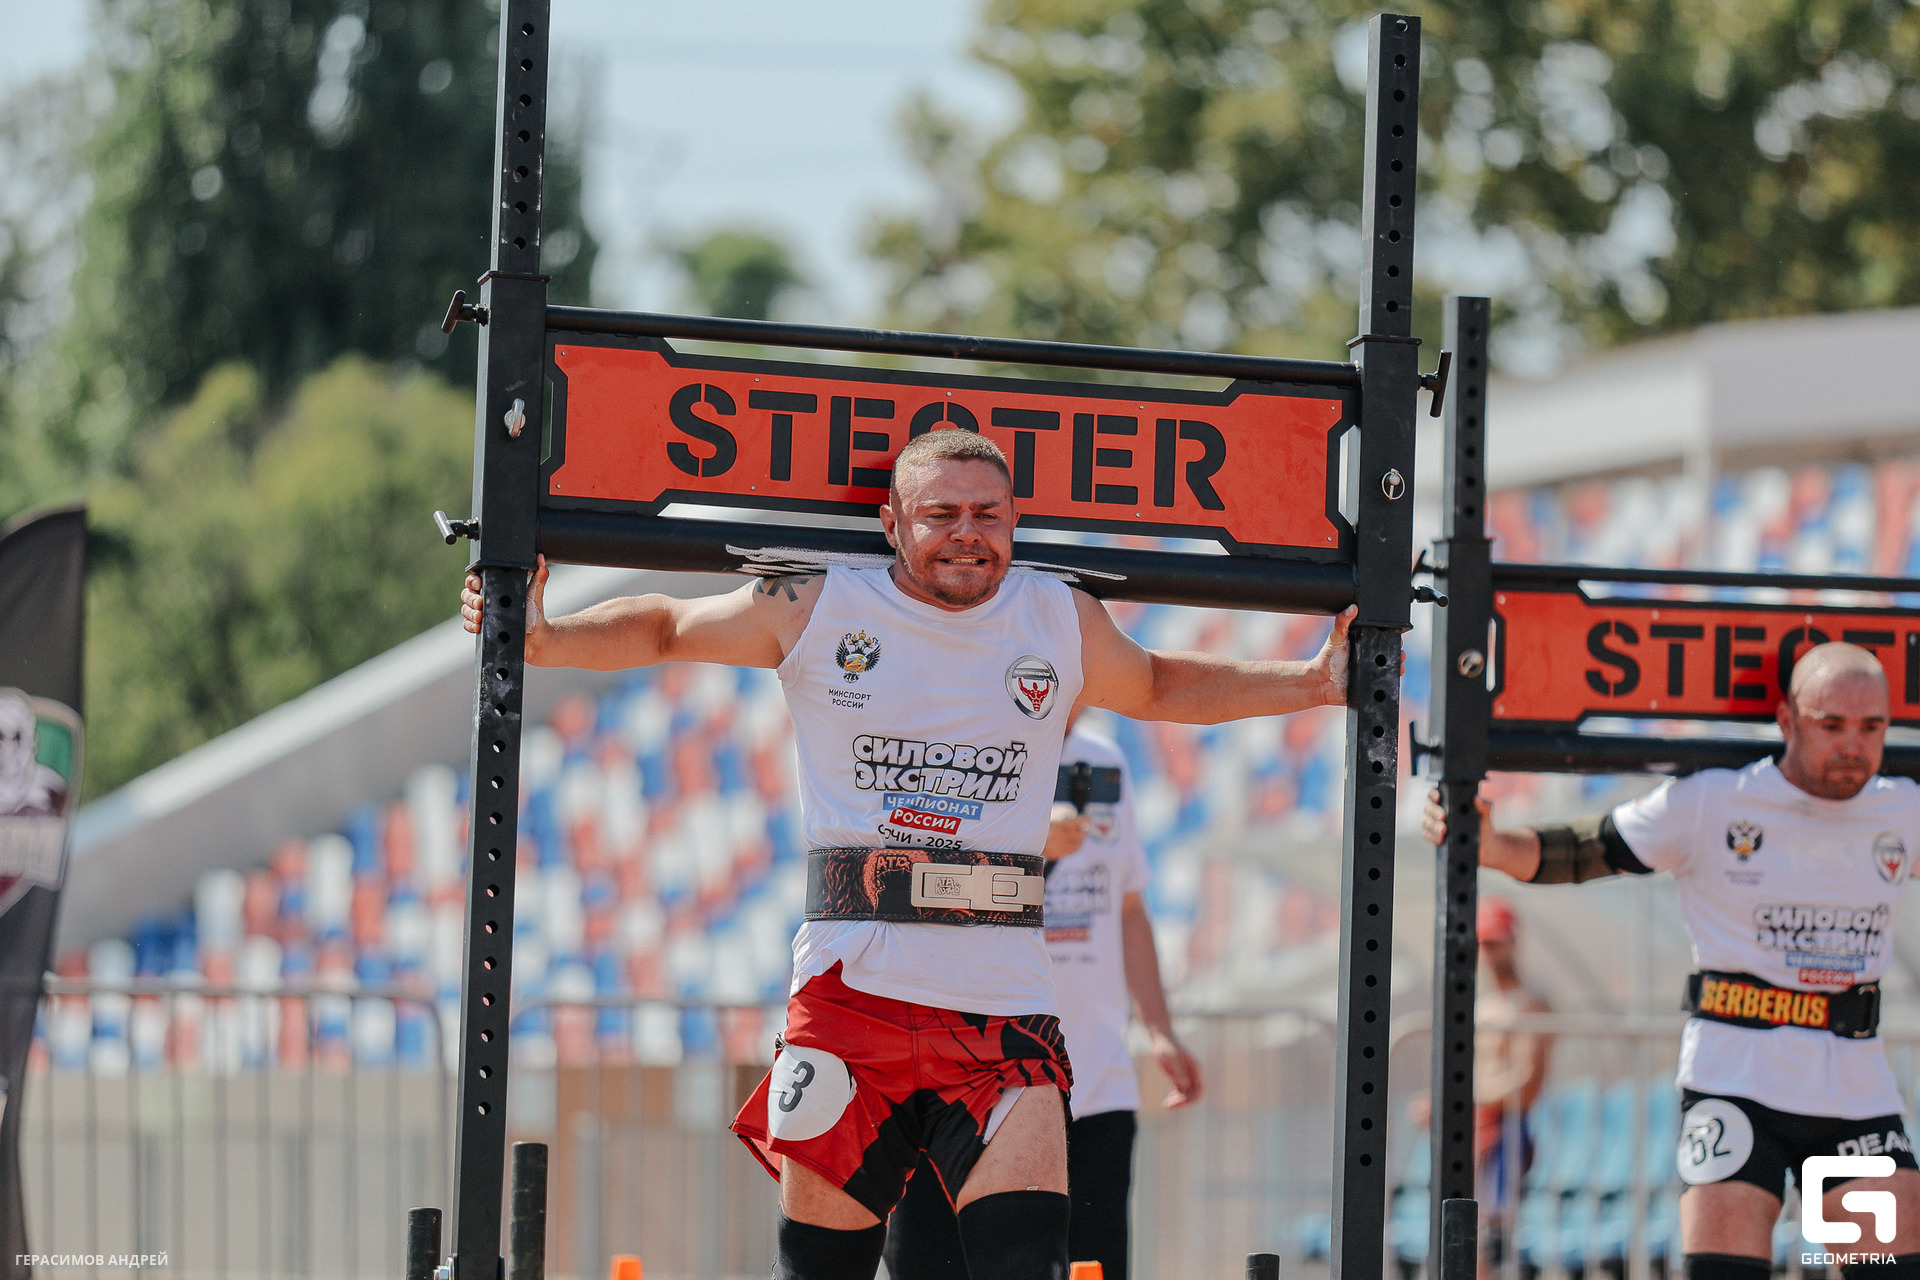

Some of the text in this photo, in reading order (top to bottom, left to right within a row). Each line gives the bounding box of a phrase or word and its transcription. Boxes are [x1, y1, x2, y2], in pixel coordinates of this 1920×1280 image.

[828, 688, 872, 701] МИНСПОРТ
[831, 698, 864, 709] РОССИИ
[852, 734, 1028, 775] СИЛОВОЙ
[854, 761, 1022, 802] ЭКСТРИМ
[886, 795, 980, 817] ЧЕМПИОНАТ
[893, 810, 957, 831] РОССИИ
[924, 836, 963, 850] 2025
[1753, 902, 1889, 932] СИЛОВОЙ
[778, 1060, 815, 1113] 3
[1837, 1130, 1910, 1156] DEA
